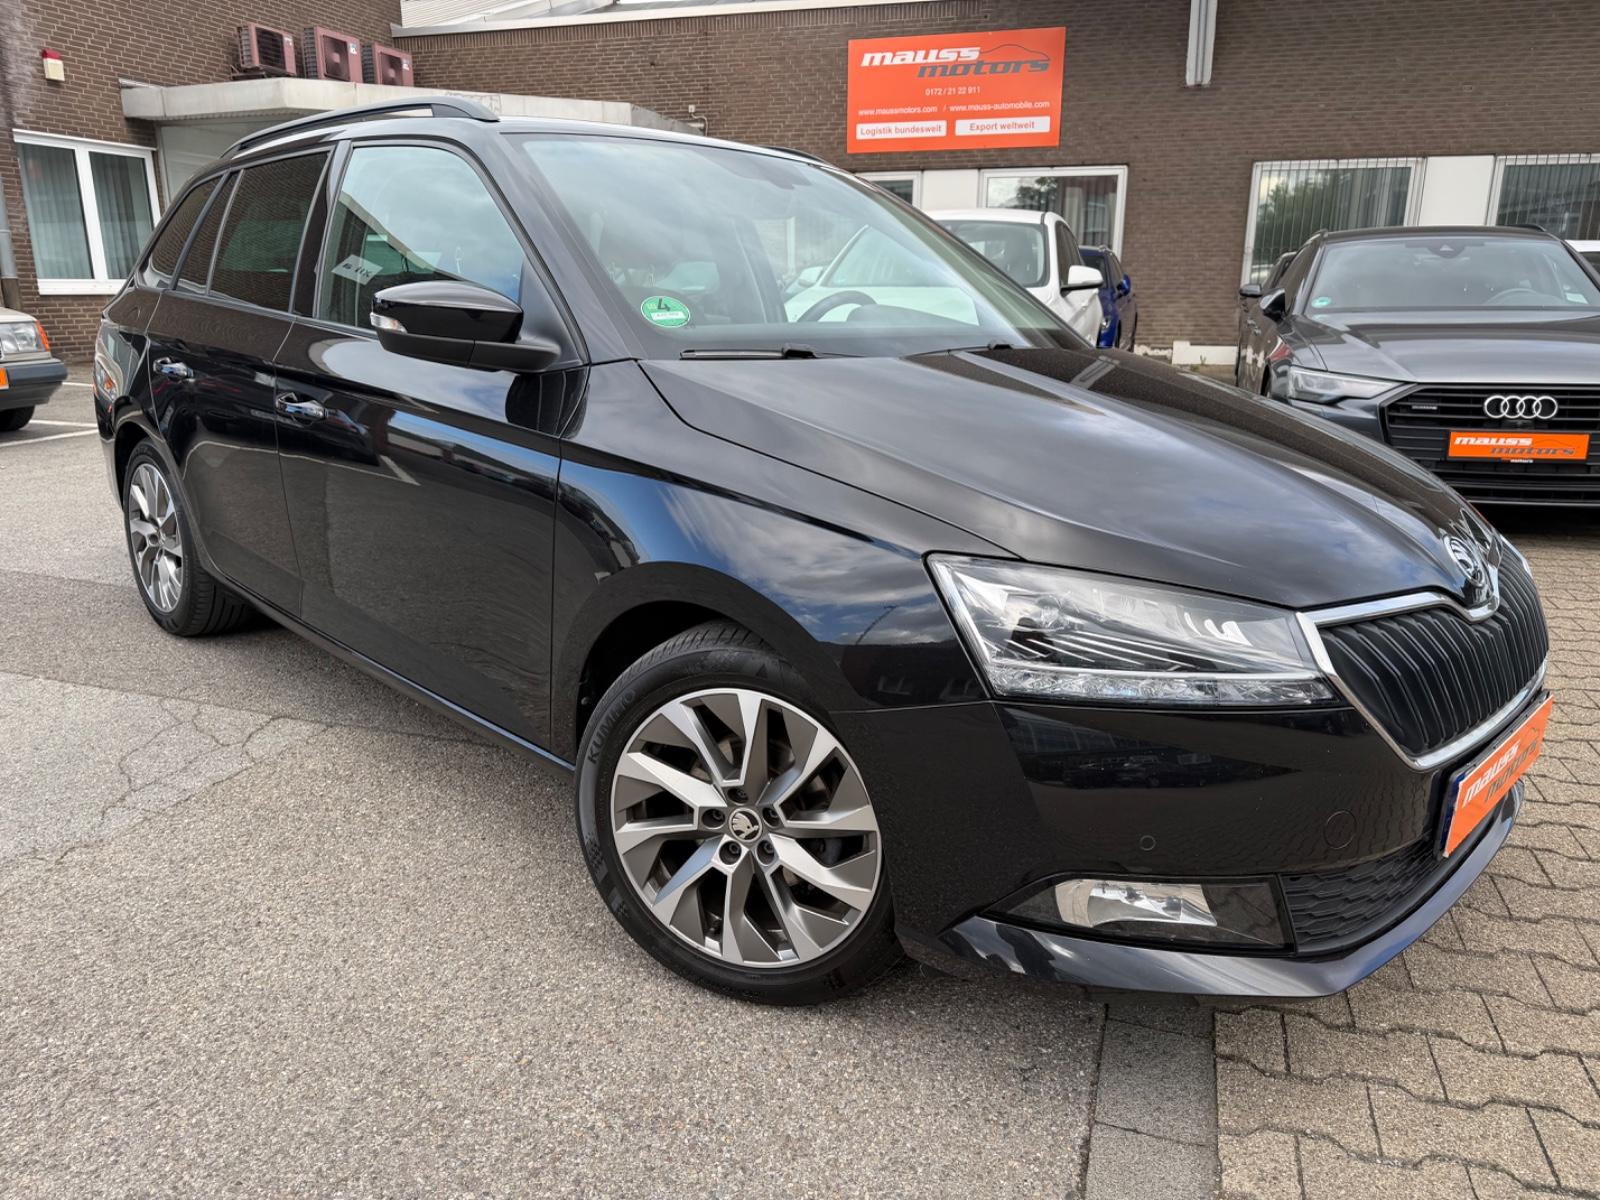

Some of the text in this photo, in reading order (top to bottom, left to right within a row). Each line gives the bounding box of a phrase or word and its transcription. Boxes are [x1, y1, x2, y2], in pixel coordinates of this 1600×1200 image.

[860, 46, 981, 67] mauss
[917, 59, 1050, 78] motors
[925, 87, 942, 97] 0172
[947, 87, 957, 96] 21
[957, 87, 967, 95] 22
[967, 86, 981, 95] 911
[858, 105, 938, 116] www.maussmotors.com
[949, 100, 1050, 112] www.mauss-automobile.com
[860, 124, 942, 137] Logistik bundesweit
[968, 120, 1035, 132] Export weltweit
[1454, 436, 1534, 447] mauss
[1461, 739, 1521, 809] mauss
